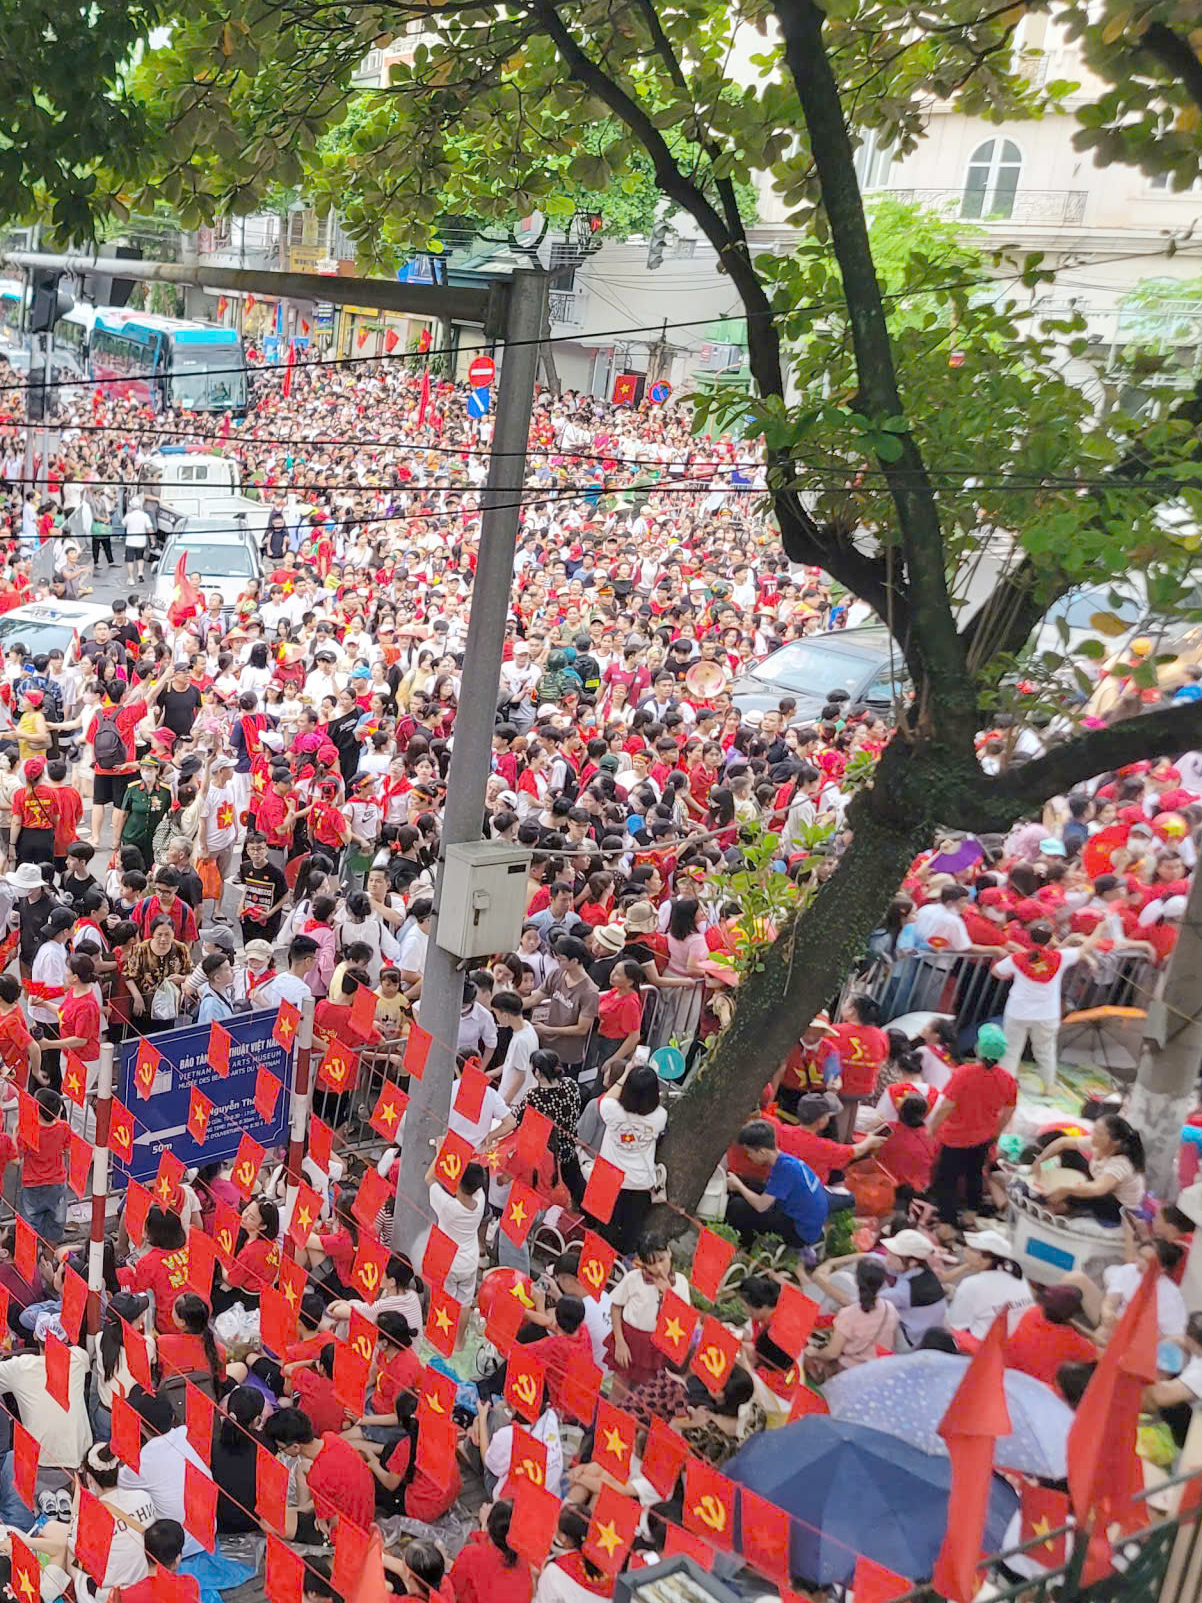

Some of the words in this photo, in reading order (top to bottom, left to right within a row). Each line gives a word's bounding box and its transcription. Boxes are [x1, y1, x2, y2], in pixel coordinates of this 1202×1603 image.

[179, 1054, 195, 1070] BẢO
[195, 1052, 209, 1066] TÀN
[228, 1042, 250, 1057] THUẬT
[251, 1038, 265, 1055] VIỆT
[232, 1058, 251, 1068] ARTS
[199, 1076, 211, 1085] DES
[151, 1143, 173, 1154] 50m
